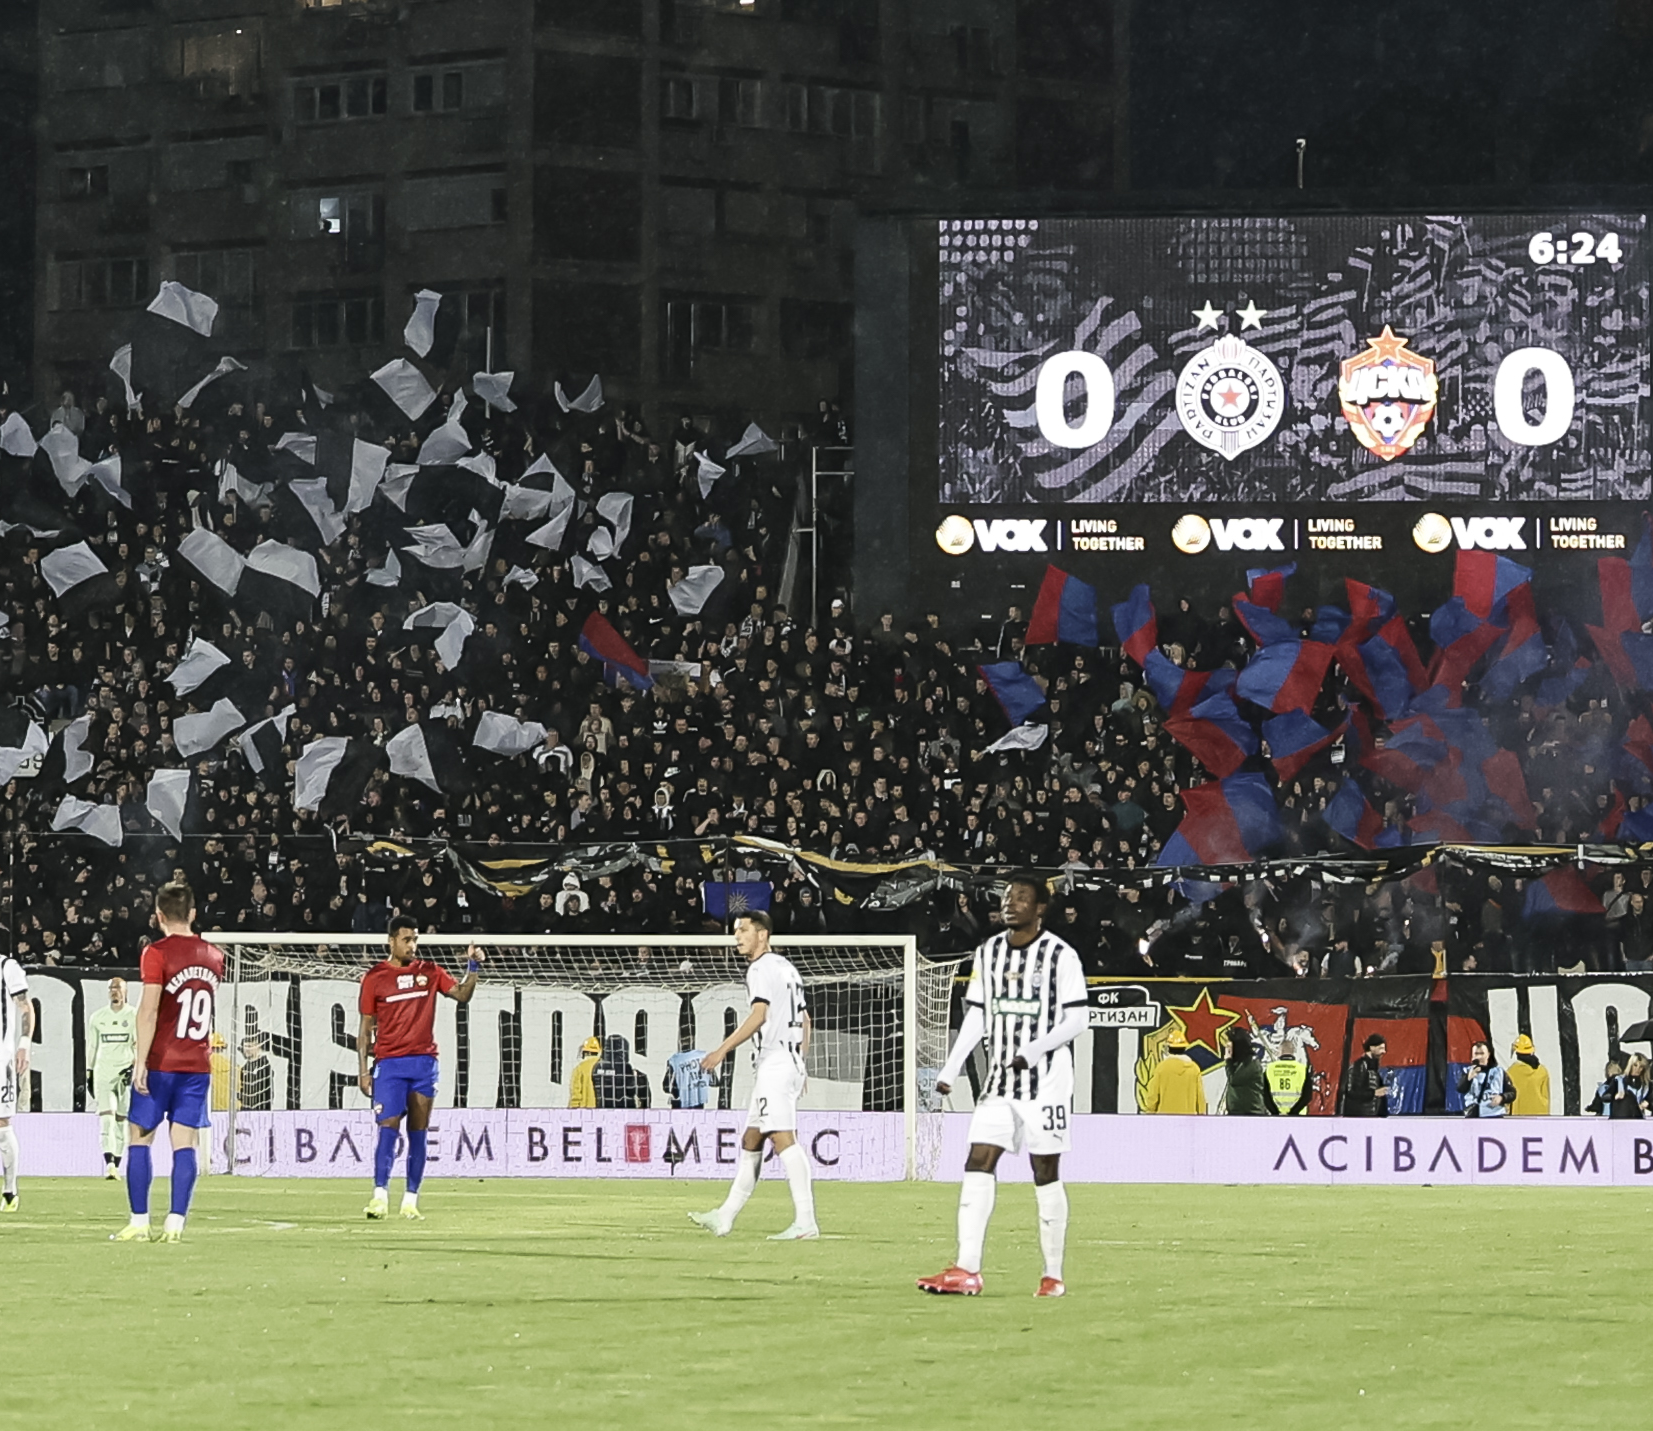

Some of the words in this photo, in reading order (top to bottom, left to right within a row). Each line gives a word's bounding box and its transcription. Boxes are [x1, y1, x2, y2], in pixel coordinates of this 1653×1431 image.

[1529, 232, 1622, 264] 6:24
[1037, 350, 1115, 449] 0
[1493, 347, 1575, 447] 0
[973, 519, 1048, 552] VOX
[1071, 519, 1117, 533] LIVING
[1209, 518, 1285, 551] VOX
[1308, 518, 1354, 532] LIVING
[1450, 517, 1526, 550] VOX
[1550, 517, 1597, 531] LIVING
[1072, 536, 1145, 552] TOGETHER
[1309, 535, 1382, 550] TOGETHER
[1551, 534, 1625, 549] TOGETHER
[1097, 991, 1119, 1005] ФК
[176, 988, 212, 1041] 19
[1089, 1010, 1148, 1023] РТИЗАН
[1, 1085, 14, 1104] 26
[1279, 1077, 1291, 1090] 86
[1042, 1104, 1067, 1131] 39
[527, 1126, 612, 1163] BEL
[664, 1126, 840, 1167] MEC
[1273, 1134, 1600, 1174] ACIBADEM
